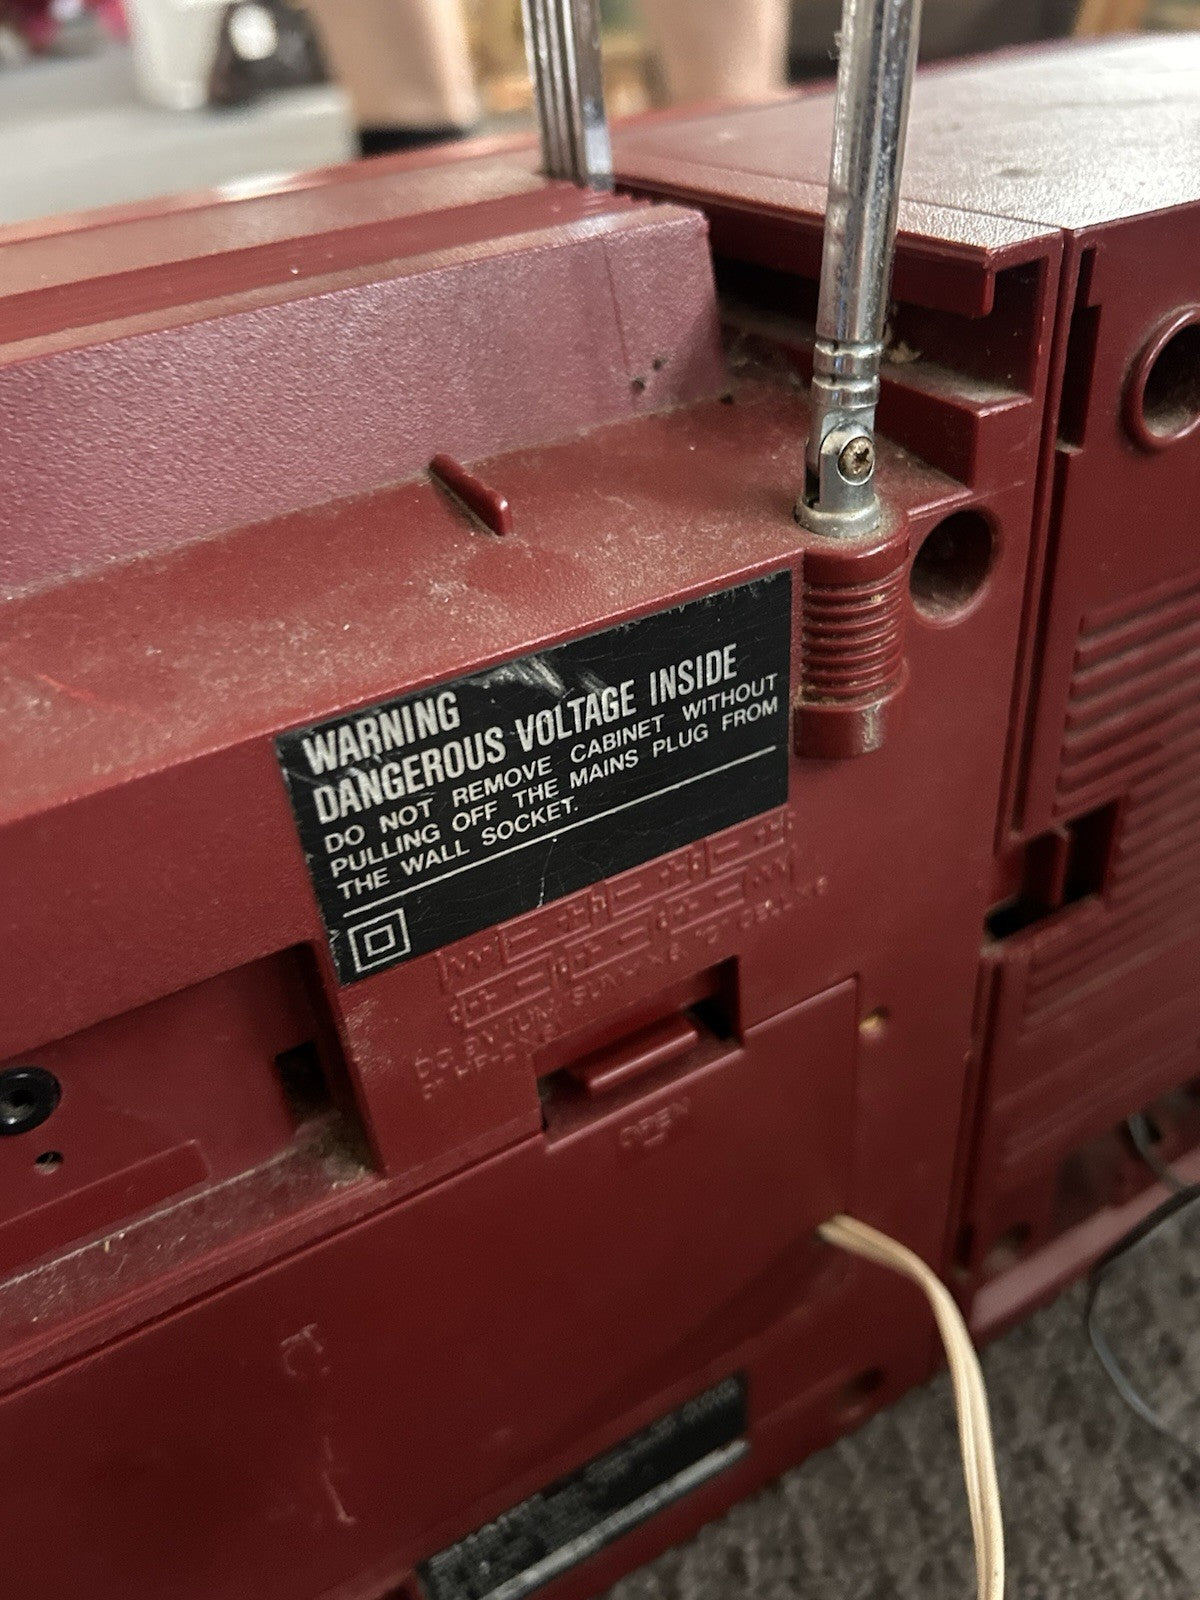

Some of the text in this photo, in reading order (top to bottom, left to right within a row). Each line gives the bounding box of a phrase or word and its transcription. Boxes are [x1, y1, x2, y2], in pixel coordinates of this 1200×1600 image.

[302, 692, 460, 774] WARNING
[313, 644, 737, 824] DANGEROUS VOLTAGE INSIDE
[325, 673, 777, 853] DO NOT REMOVE CABINET WITHOUT
[331, 697, 777, 877] PULLING OFF THE MAINS PLUG FROM
[337, 796, 578, 899] THE WALL SOCKET.
